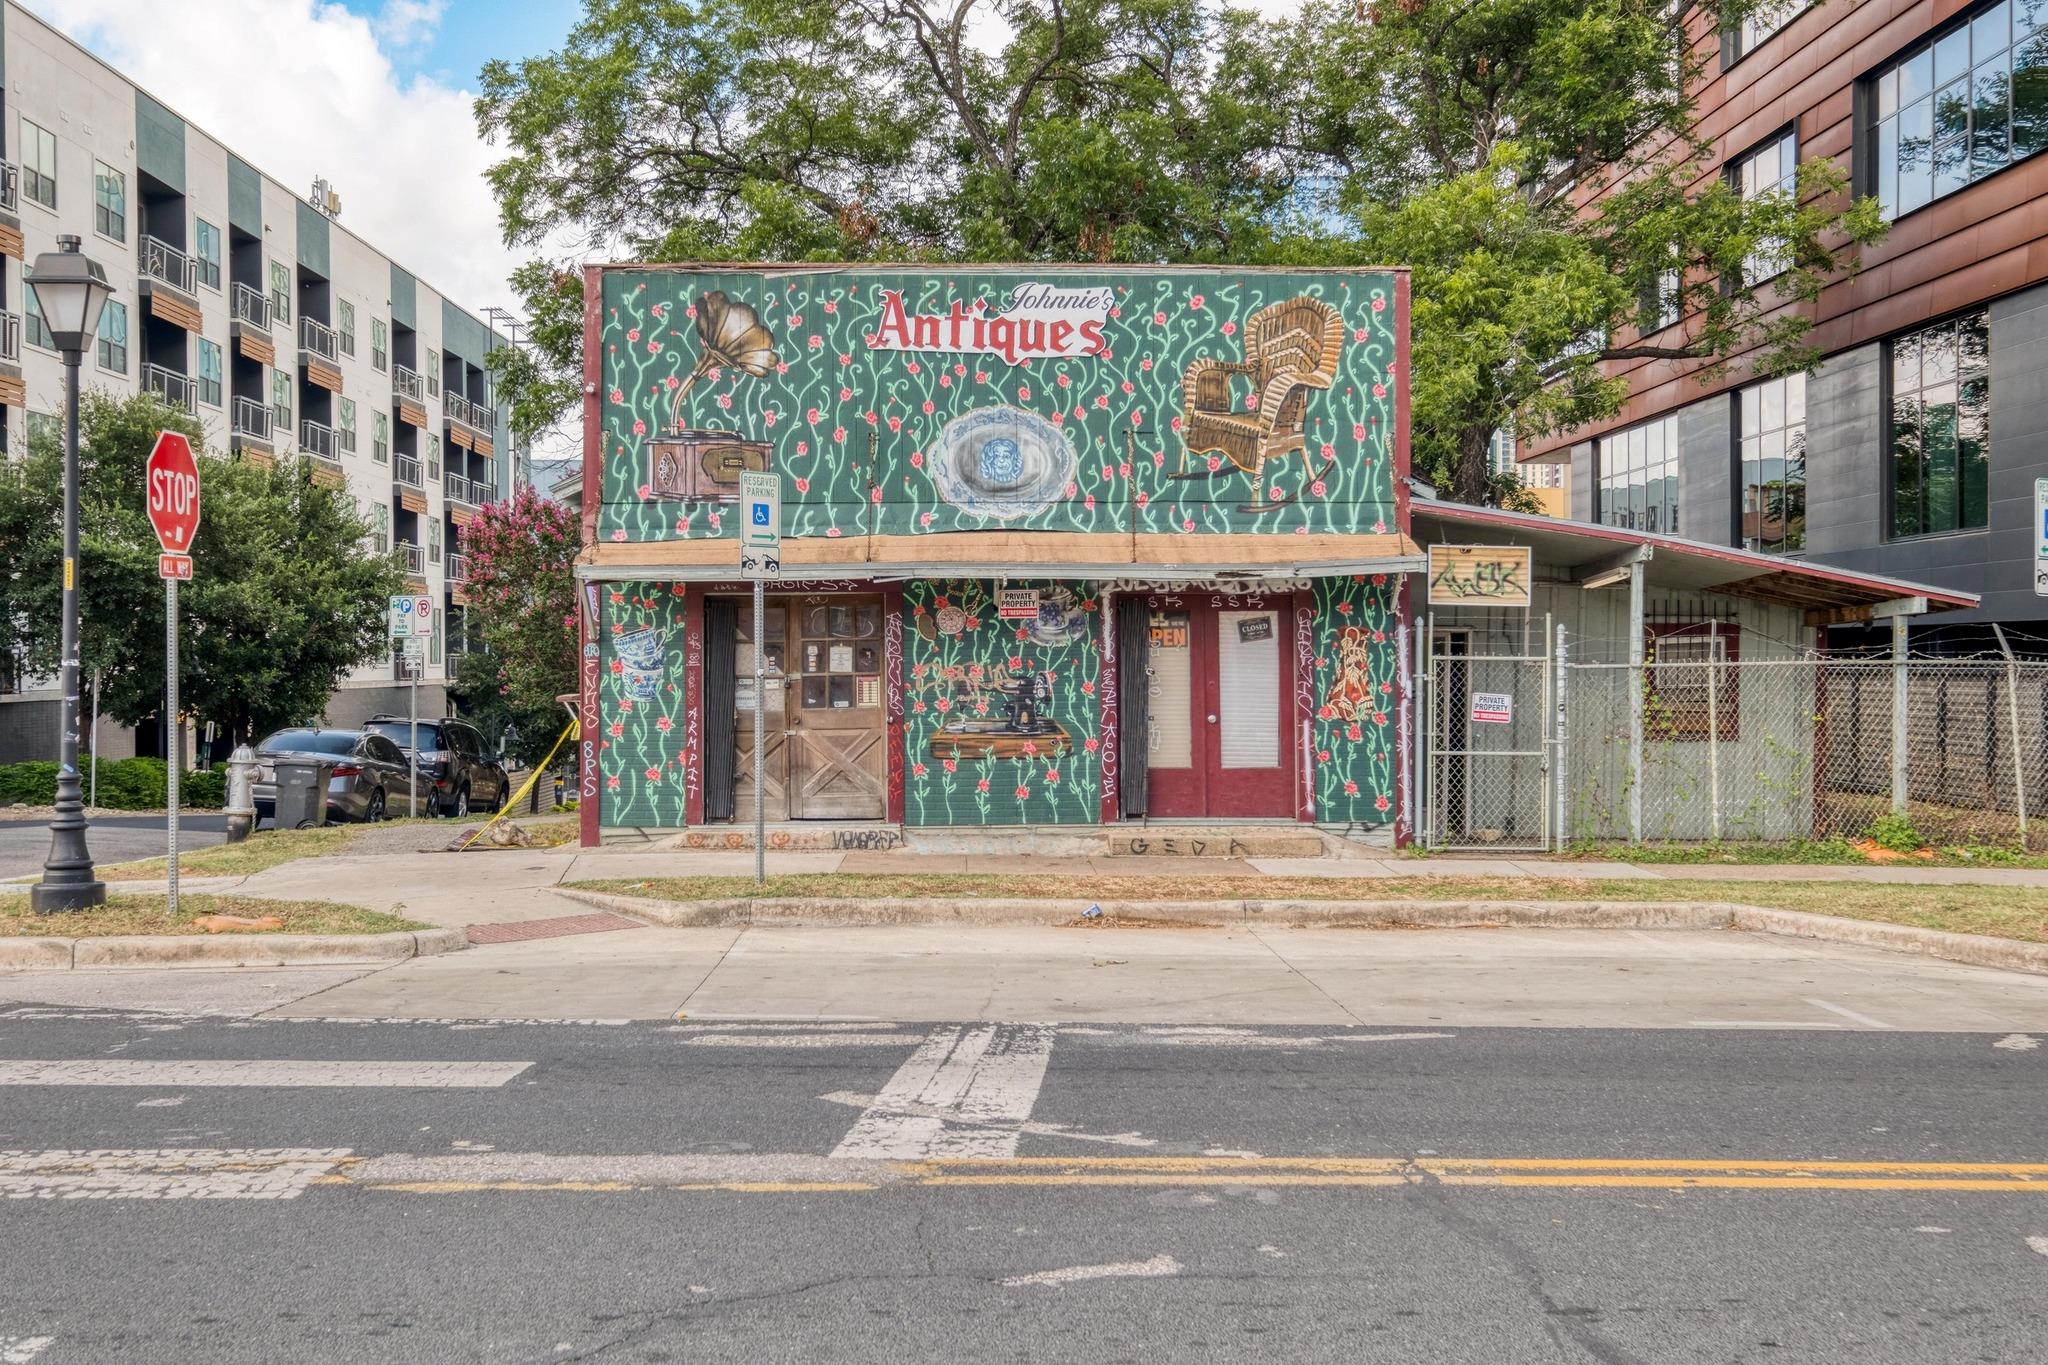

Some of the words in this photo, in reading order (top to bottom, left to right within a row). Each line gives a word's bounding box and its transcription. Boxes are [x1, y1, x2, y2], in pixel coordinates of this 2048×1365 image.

[999, 284, 1114, 313] Johnnie's
[868, 290, 1106, 364] Antiques
[743, 475, 777, 488] RESERVED
[152, 467, 197, 516] STOP
[746, 487, 775, 498] PARKING
[162, 559, 175, 574] ALL
[1004, 592, 1033, 600] PRIVATE
[1001, 600, 1036, 608] PROPERTY
[1241, 623, 1268, 633] CLOSED
[1151, 628, 1185, 647] PEN
[1479, 696, 1505, 705] PRIVATE
[1474, 703, 1508, 713] PROPERTY
[687, 706, 698, 800] ARMPIT
